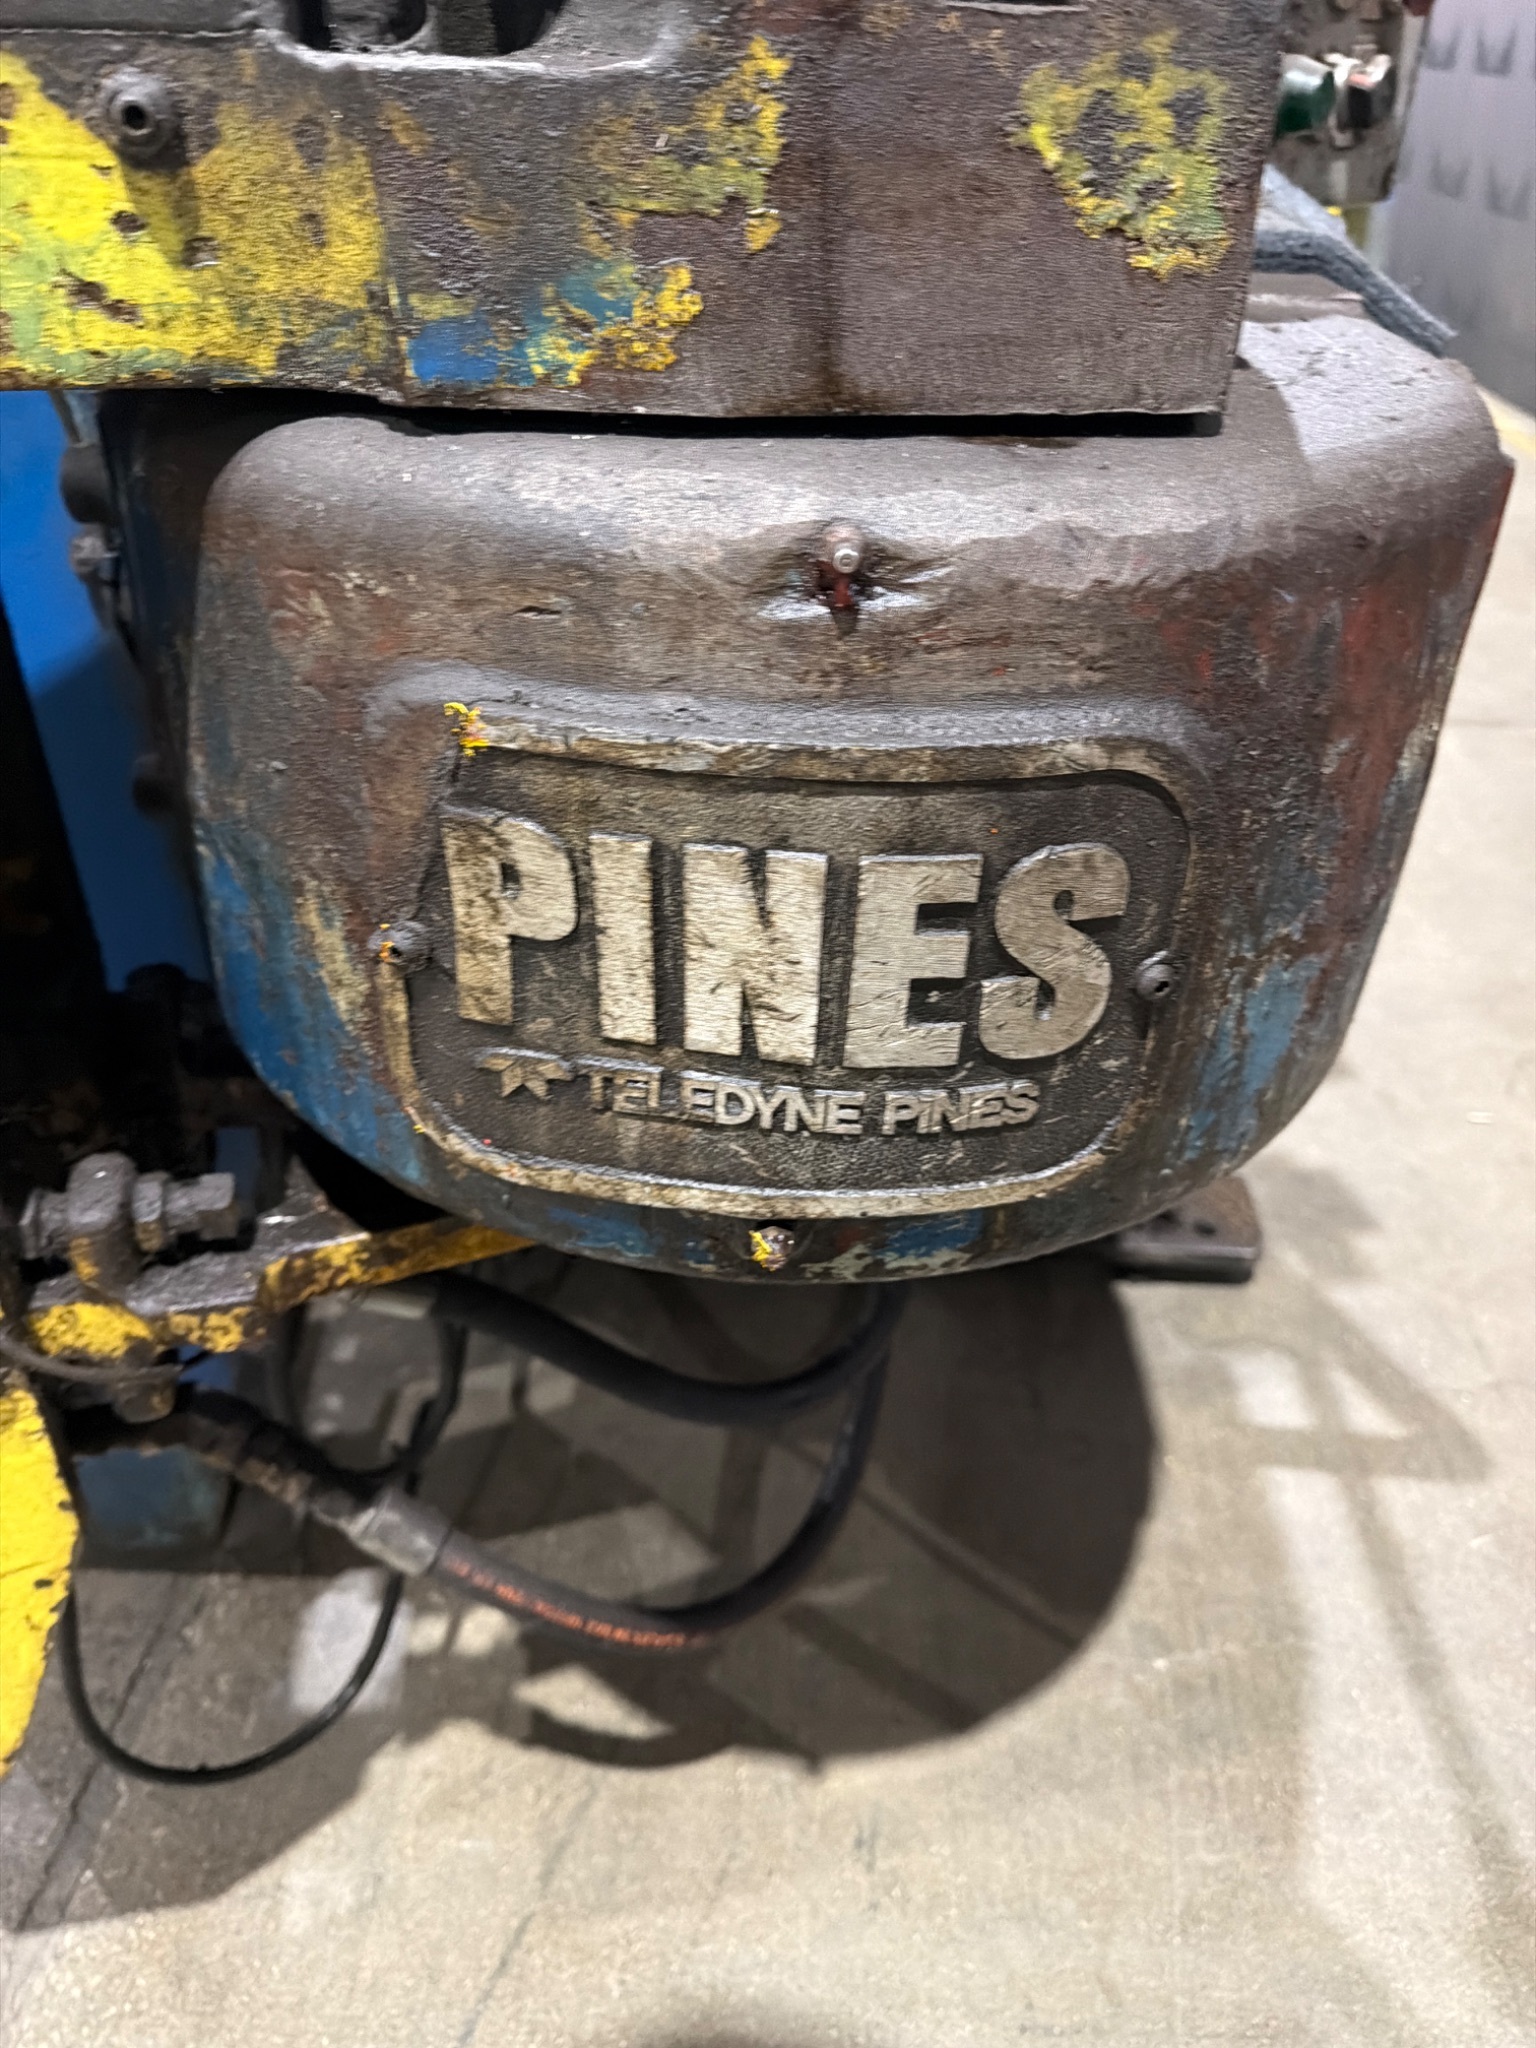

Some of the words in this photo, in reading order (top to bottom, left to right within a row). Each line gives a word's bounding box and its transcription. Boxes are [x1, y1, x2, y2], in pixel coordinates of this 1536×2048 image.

[440, 804, 1130, 1068] PINES
[576, 1056, 866, 1136] TELEDYNE
[881, 1079, 1041, 1136] PINES
